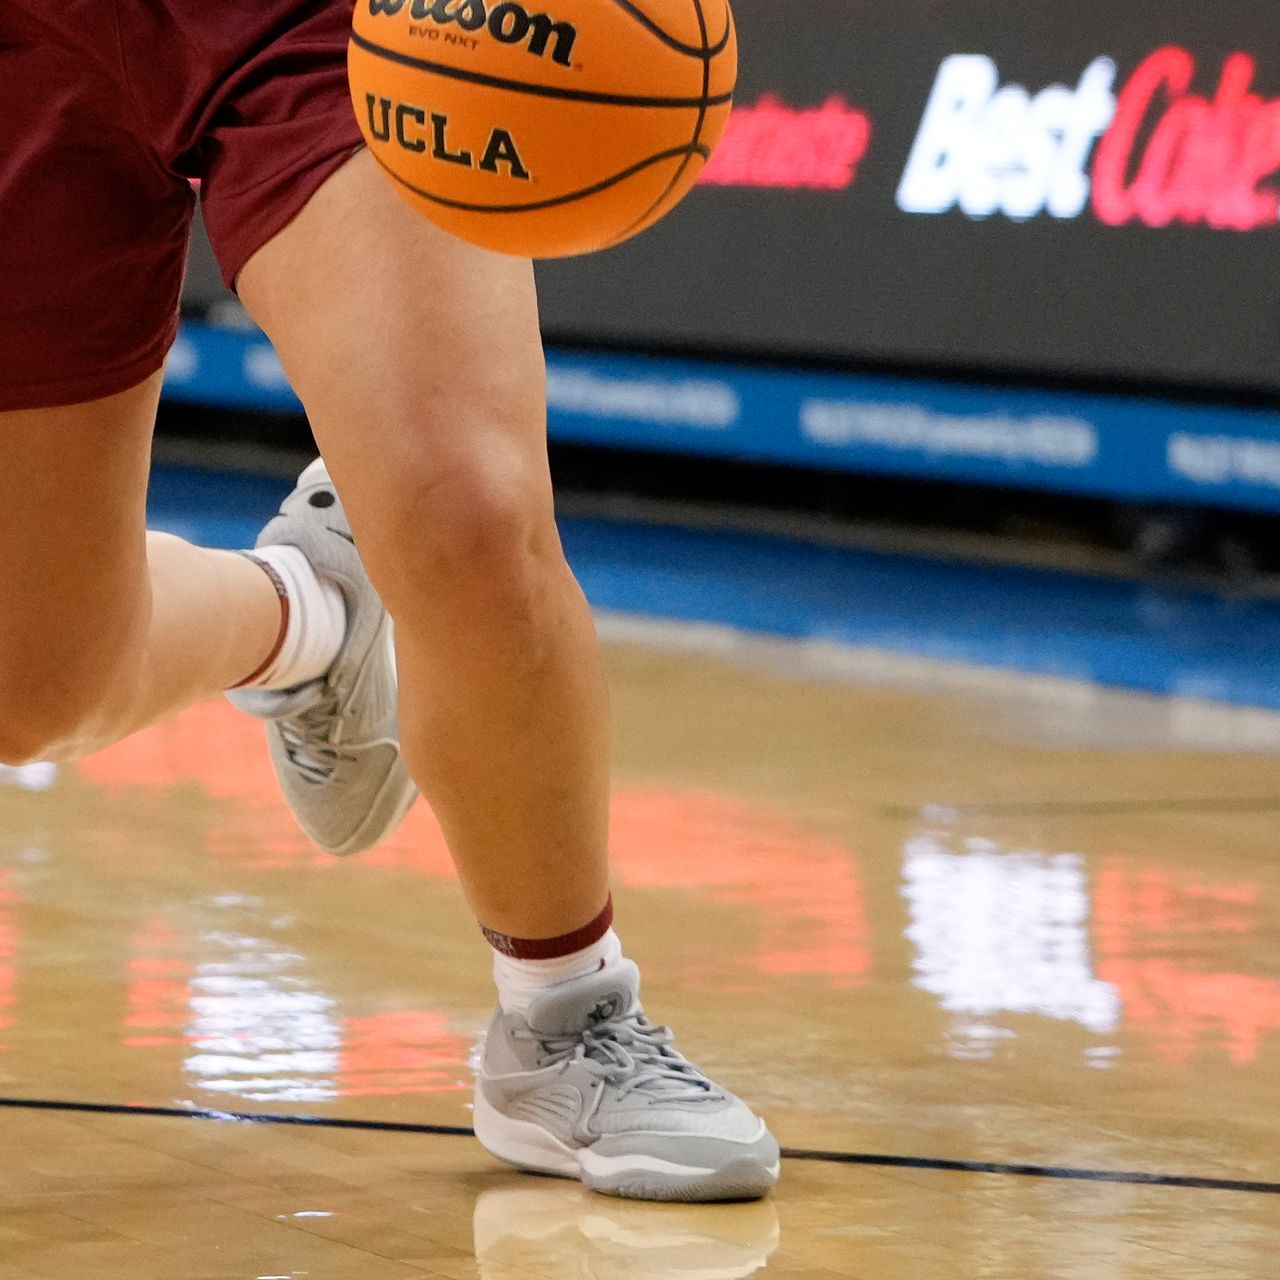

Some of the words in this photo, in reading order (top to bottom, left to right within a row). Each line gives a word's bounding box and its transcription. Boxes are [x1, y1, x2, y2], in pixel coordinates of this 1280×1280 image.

[409, 26, 439, 39] EVO
[445, 33, 477, 51] NXT
[365, 93, 531, 180] UCLA
[896, 54, 1117, 222] Best
